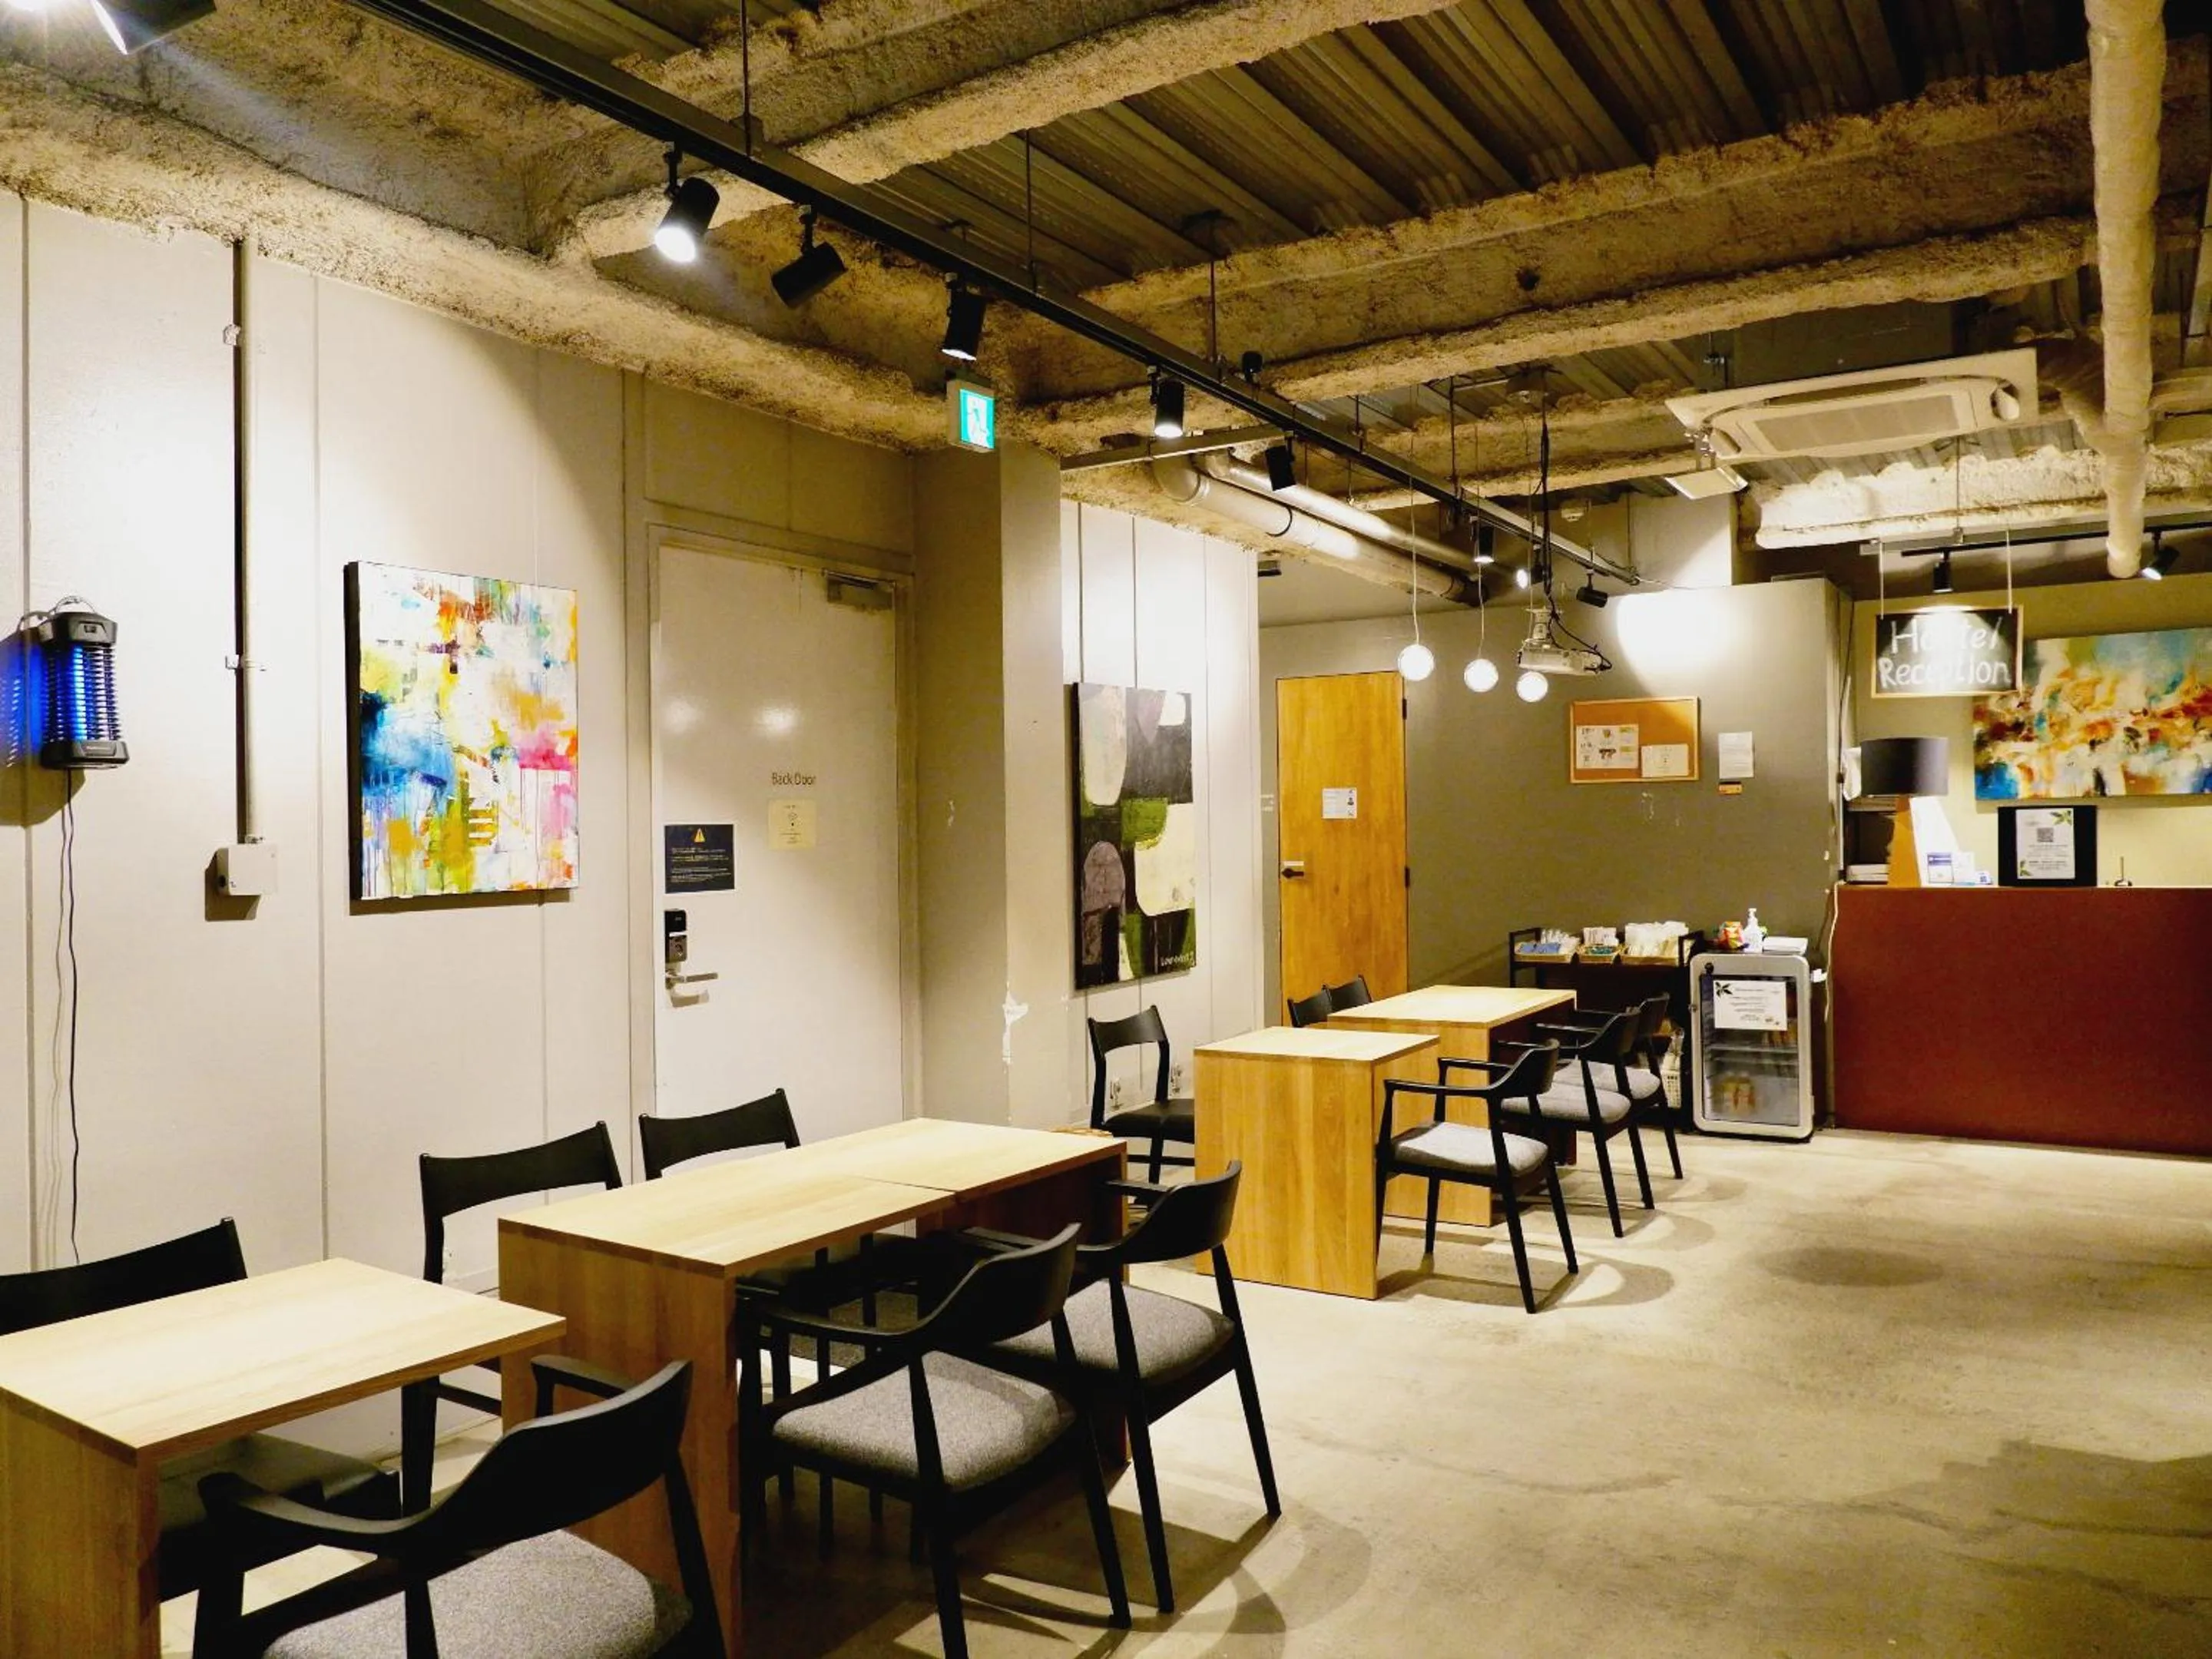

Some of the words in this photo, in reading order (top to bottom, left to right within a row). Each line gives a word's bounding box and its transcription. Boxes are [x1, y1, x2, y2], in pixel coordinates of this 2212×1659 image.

[1891, 617, 2003, 654] Hotel
[771, 772, 792, 785] Back
[794, 772, 816, 785] Door
